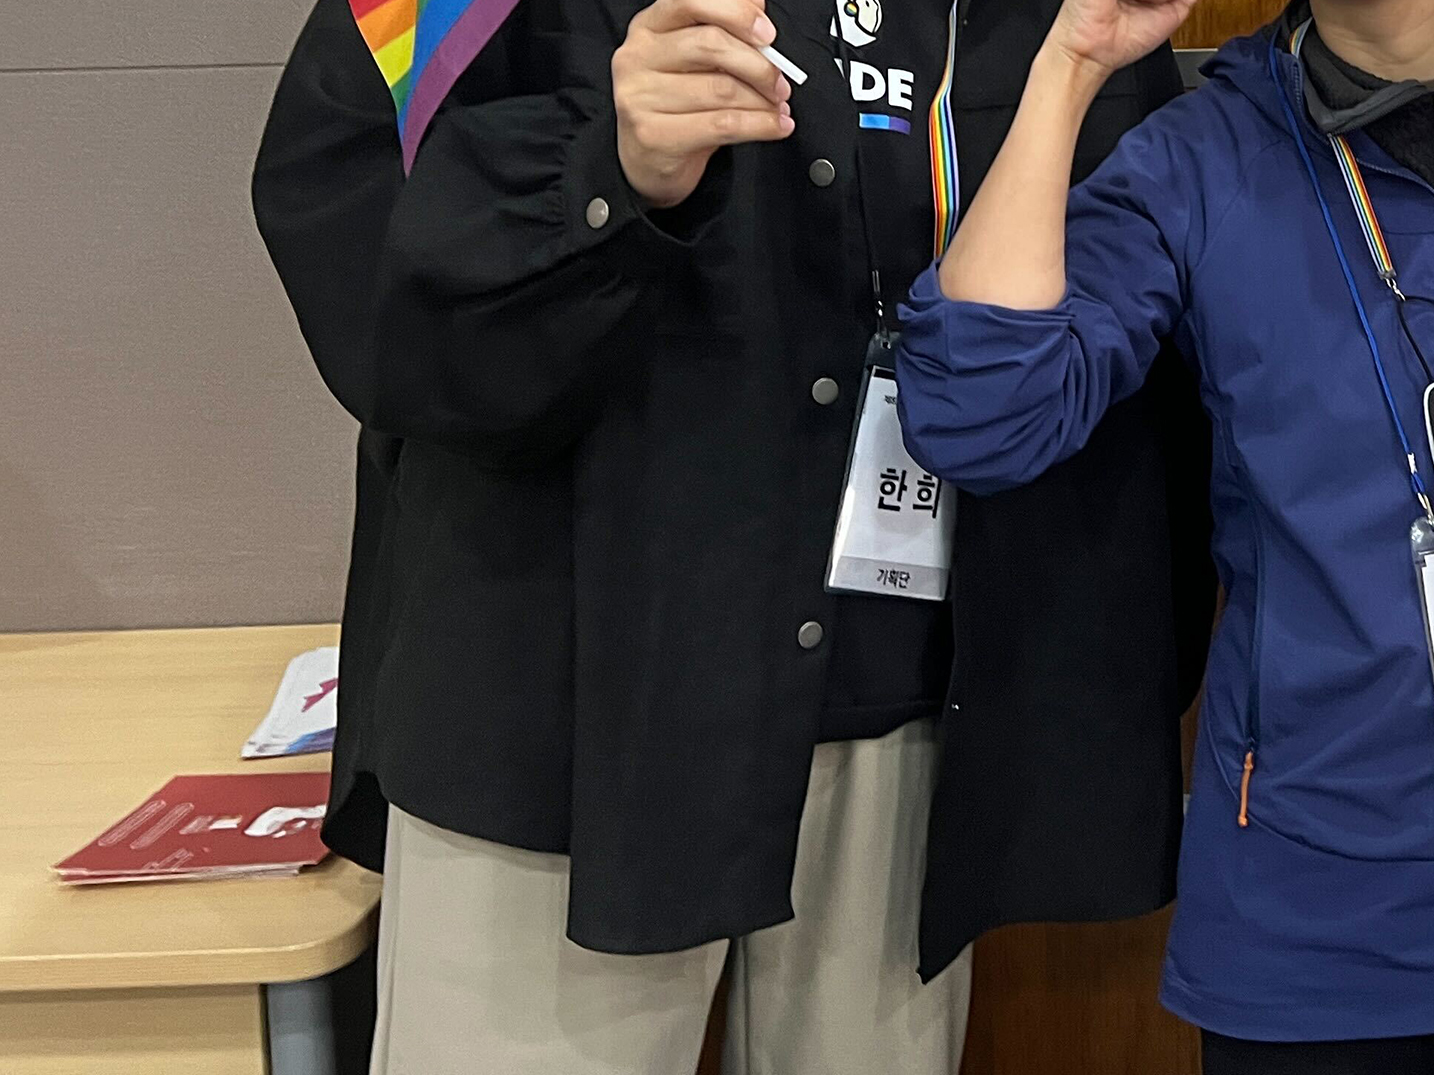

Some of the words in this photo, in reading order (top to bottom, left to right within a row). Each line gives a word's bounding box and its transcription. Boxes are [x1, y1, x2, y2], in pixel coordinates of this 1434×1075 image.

[833, 57, 914, 111] DE
[877, 468, 943, 519] 한희
[876, 569, 911, 589] 기획단
